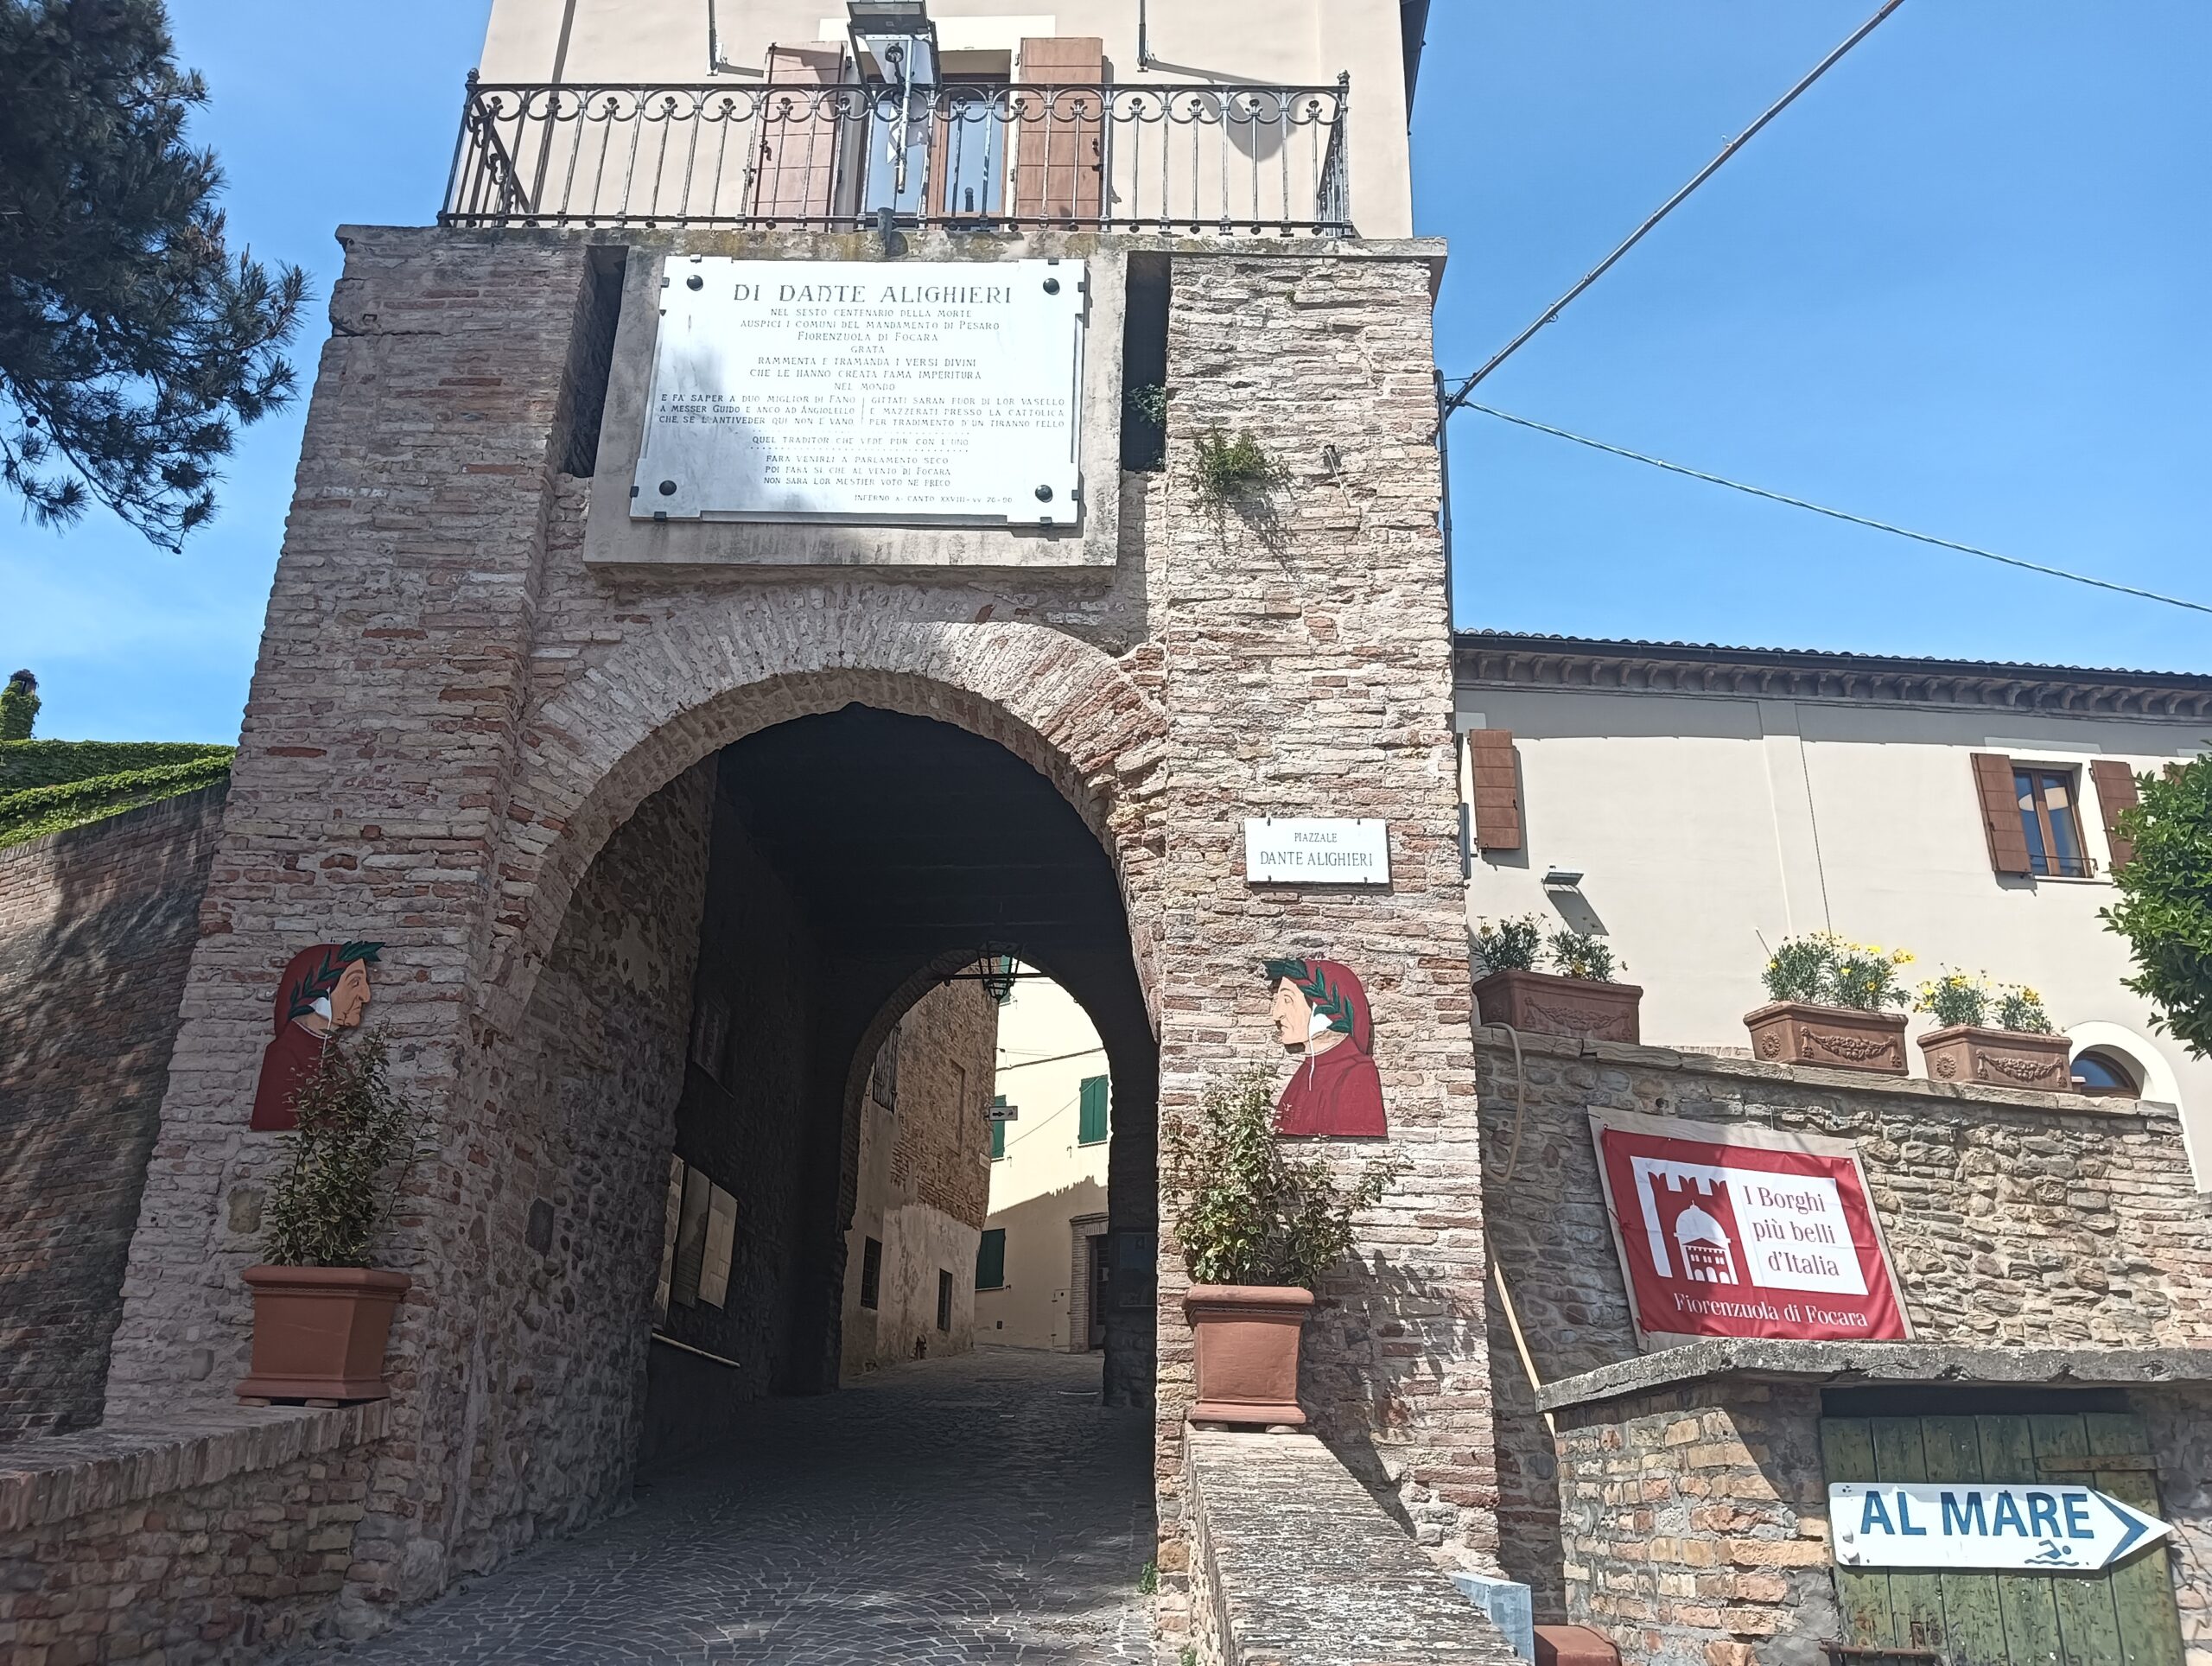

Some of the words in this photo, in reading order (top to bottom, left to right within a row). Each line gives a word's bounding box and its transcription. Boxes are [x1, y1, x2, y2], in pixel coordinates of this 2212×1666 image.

[734, 283, 760, 302] DI
[779, 284, 866, 302] DANTE
[880, 285, 1011, 303] ALIGHIERI
[959, 321, 1000, 330] PESARO
[798, 331, 871, 341] FIORENZUOLA
[895, 332, 938, 341] FOCARA
[944, 359, 976, 367] DIVINI
[830, 395, 855, 404] FANO
[713, 404, 741, 413] GUIDO
[801, 405, 855, 415] ANGIOLELLO
[1294, 832, 1338, 843] PIAZZALE
[1260, 851, 1303, 865] DANTE
[1307, 852, 1372, 867] ALIGHIERI
[1743, 1186, 1753, 1205] I
[1758, 1186, 1826, 1215] Borghi
[1752, 1219, 1785, 1242] più
[1791, 1221, 1836, 1244] belli
[1768, 1251, 1840, 1276] d'Italia
[1673, 1293, 1778, 1321] Fiorenzuola
[1783, 1302, 1802, 1323] di
[1805, 1305, 1868, 1327] Focara
[1860, 1491, 1926, 1536] AL
[1940, 1491, 2094, 1539] MARE
